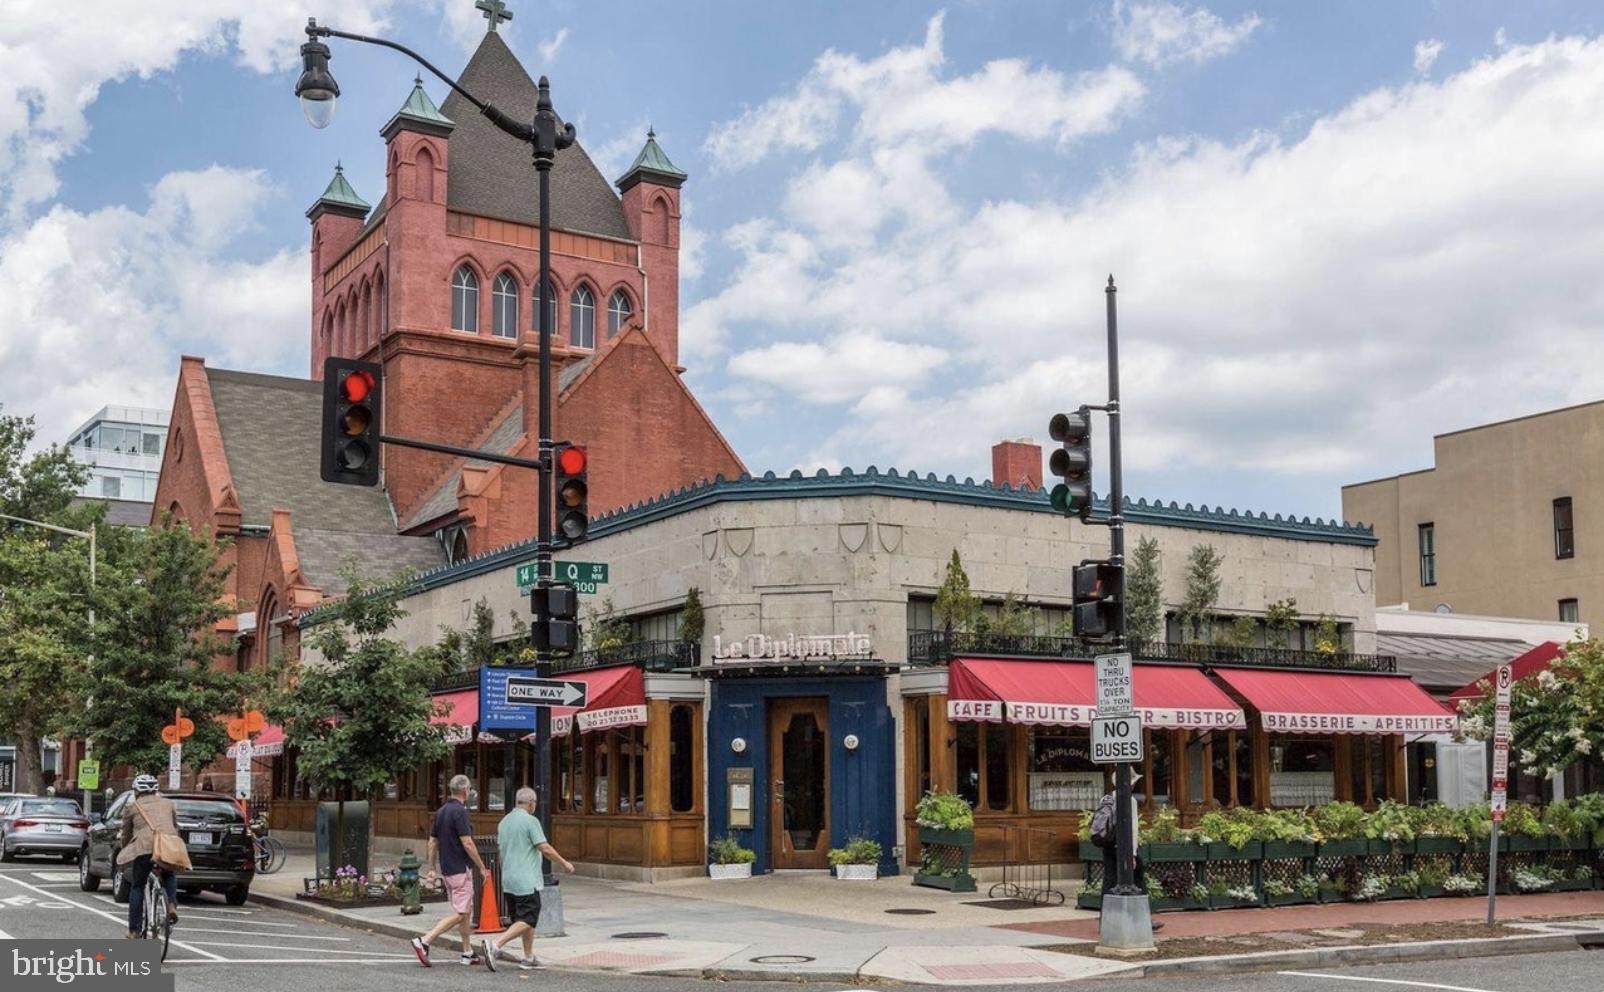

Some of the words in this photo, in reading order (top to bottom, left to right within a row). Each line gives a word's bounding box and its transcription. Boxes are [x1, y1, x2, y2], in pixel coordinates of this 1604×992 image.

[567, 564, 578, 580] Q
[713, 634, 743, 658] Le
[745, 631, 871, 662] Diplomate
[1107, 657, 1119, 667] NO
[1103, 667, 1124, 677] THRU
[1098, 676, 1130, 687] TRUCKS
[510, 686, 534, 696] ONE
[539, 688, 564, 698] WAY
[1103, 687, 1125, 697] OVER
[954, 702, 993, 716] CAFE
[1013, 704, 1080, 720] FRUITS
[1176, 710, 1237, 724] BISTRO
[1100, 705, 1130, 713] CAPACITY
[1267, 714, 1355, 729] BRASSERIE
[1375, 717, 1454, 730] APERITIFS
[1103, 720, 1129, 738] NO
[1095, 741, 1139, 757] BUSES
[1036, 754, 1048, 765] LE
